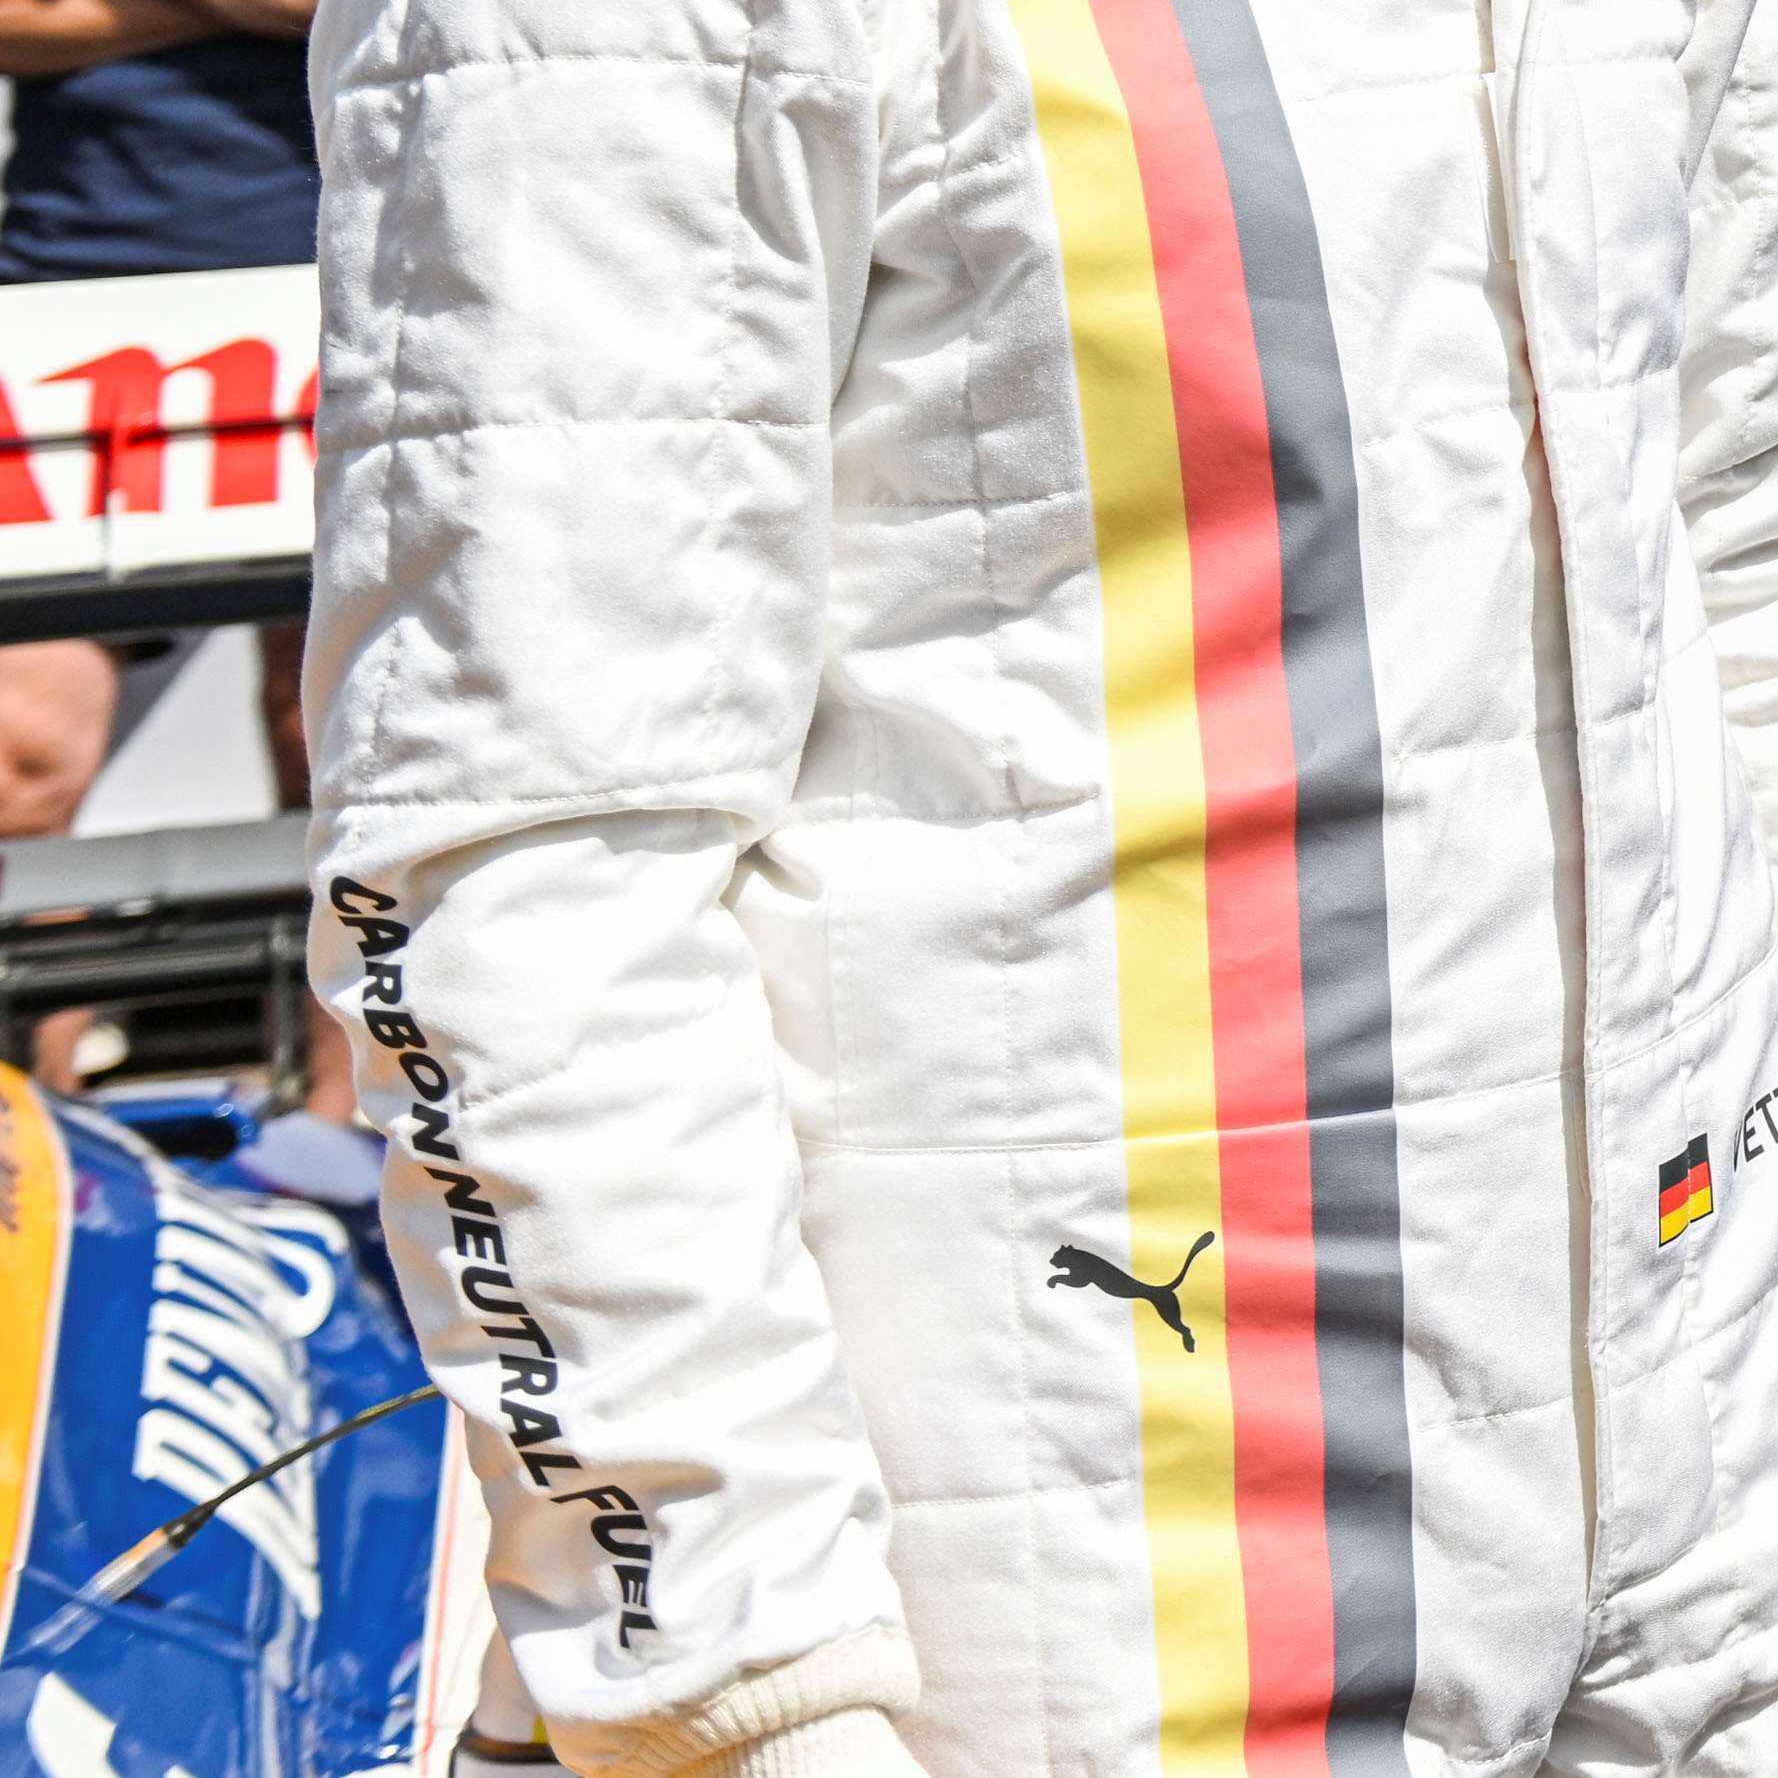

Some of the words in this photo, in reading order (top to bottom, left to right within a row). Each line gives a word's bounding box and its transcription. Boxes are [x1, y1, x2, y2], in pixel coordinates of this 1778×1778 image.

[329, 875, 460, 1162] CARBON
[424, 1165, 583, 1487] NEUTRAL
[550, 1483, 660, 1650] FUEL
